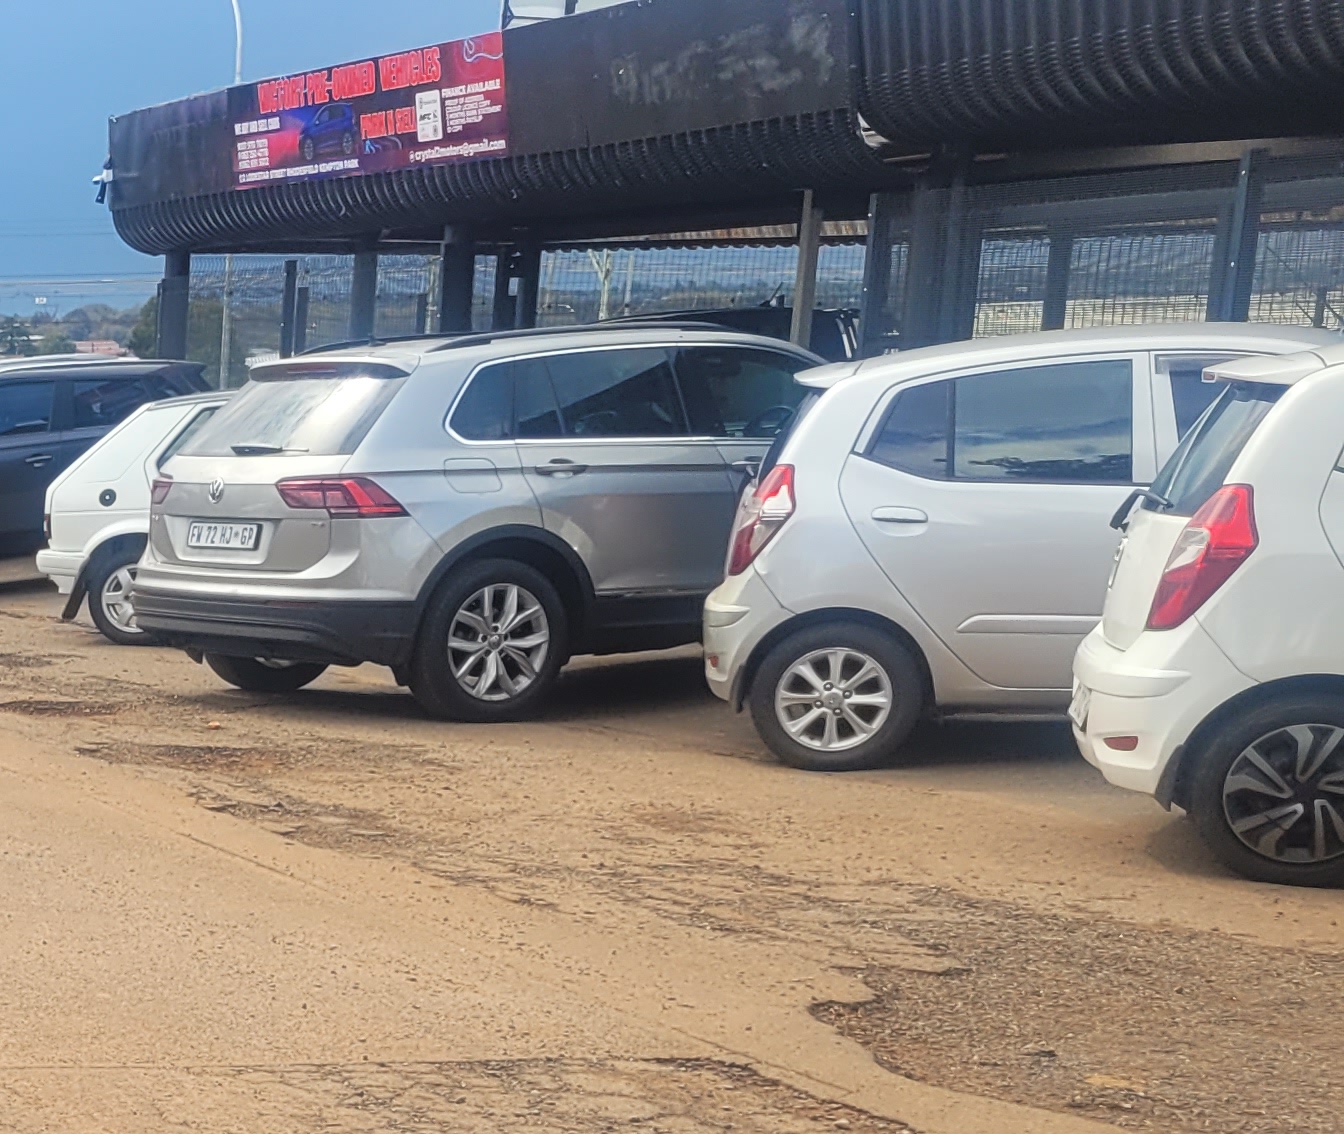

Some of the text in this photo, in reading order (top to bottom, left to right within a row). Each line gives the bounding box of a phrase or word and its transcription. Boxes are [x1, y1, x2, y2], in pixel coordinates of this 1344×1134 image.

[257, 47, 441, 114] VICTORY PRE-OWNED VEHICLES
[191, 525, 254, 545] FW 72 HJ GP
